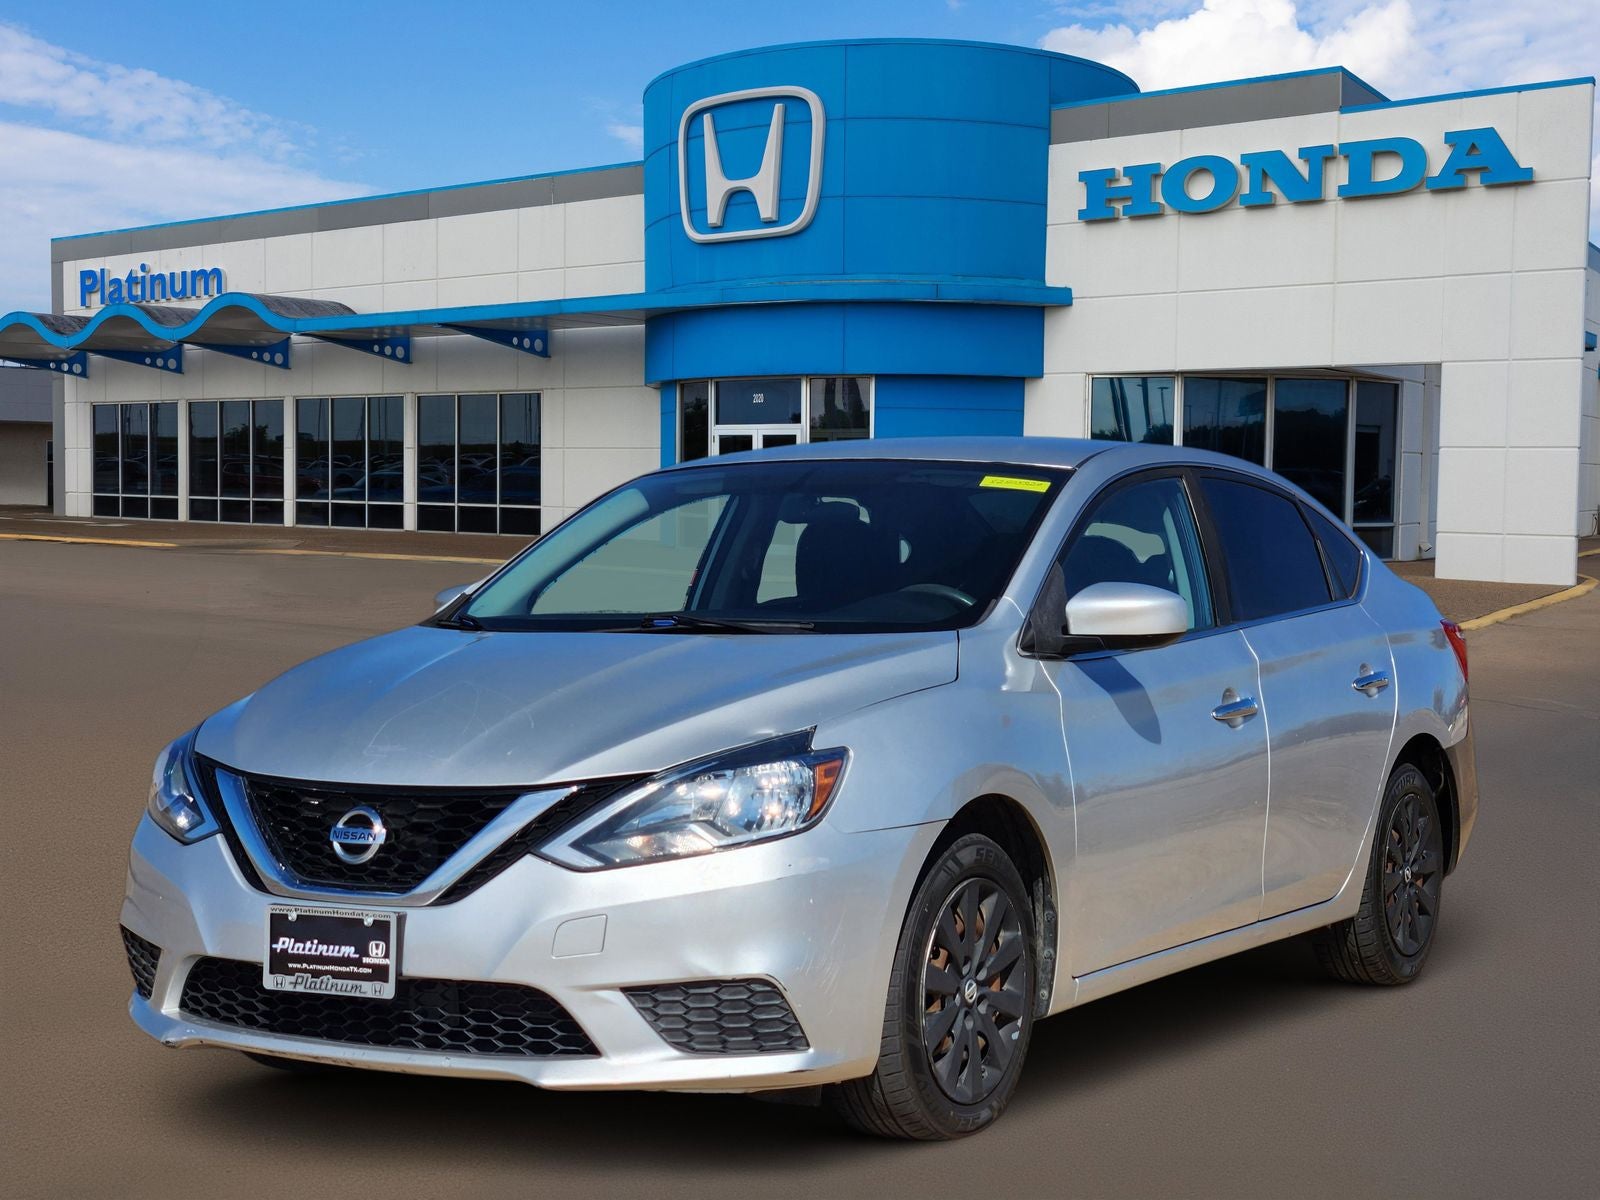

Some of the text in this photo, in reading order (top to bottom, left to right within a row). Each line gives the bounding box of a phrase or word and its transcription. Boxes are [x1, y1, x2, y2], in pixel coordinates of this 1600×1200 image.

[1078, 127, 1534, 221] HONDA
[79, 263, 225, 307] Platinum
[333, 830, 377, 841] NISSAN
[272, 937, 360, 958] Platinum
[362, 957, 391, 965] HONDA
[289, 975, 367, 994] Platinum
